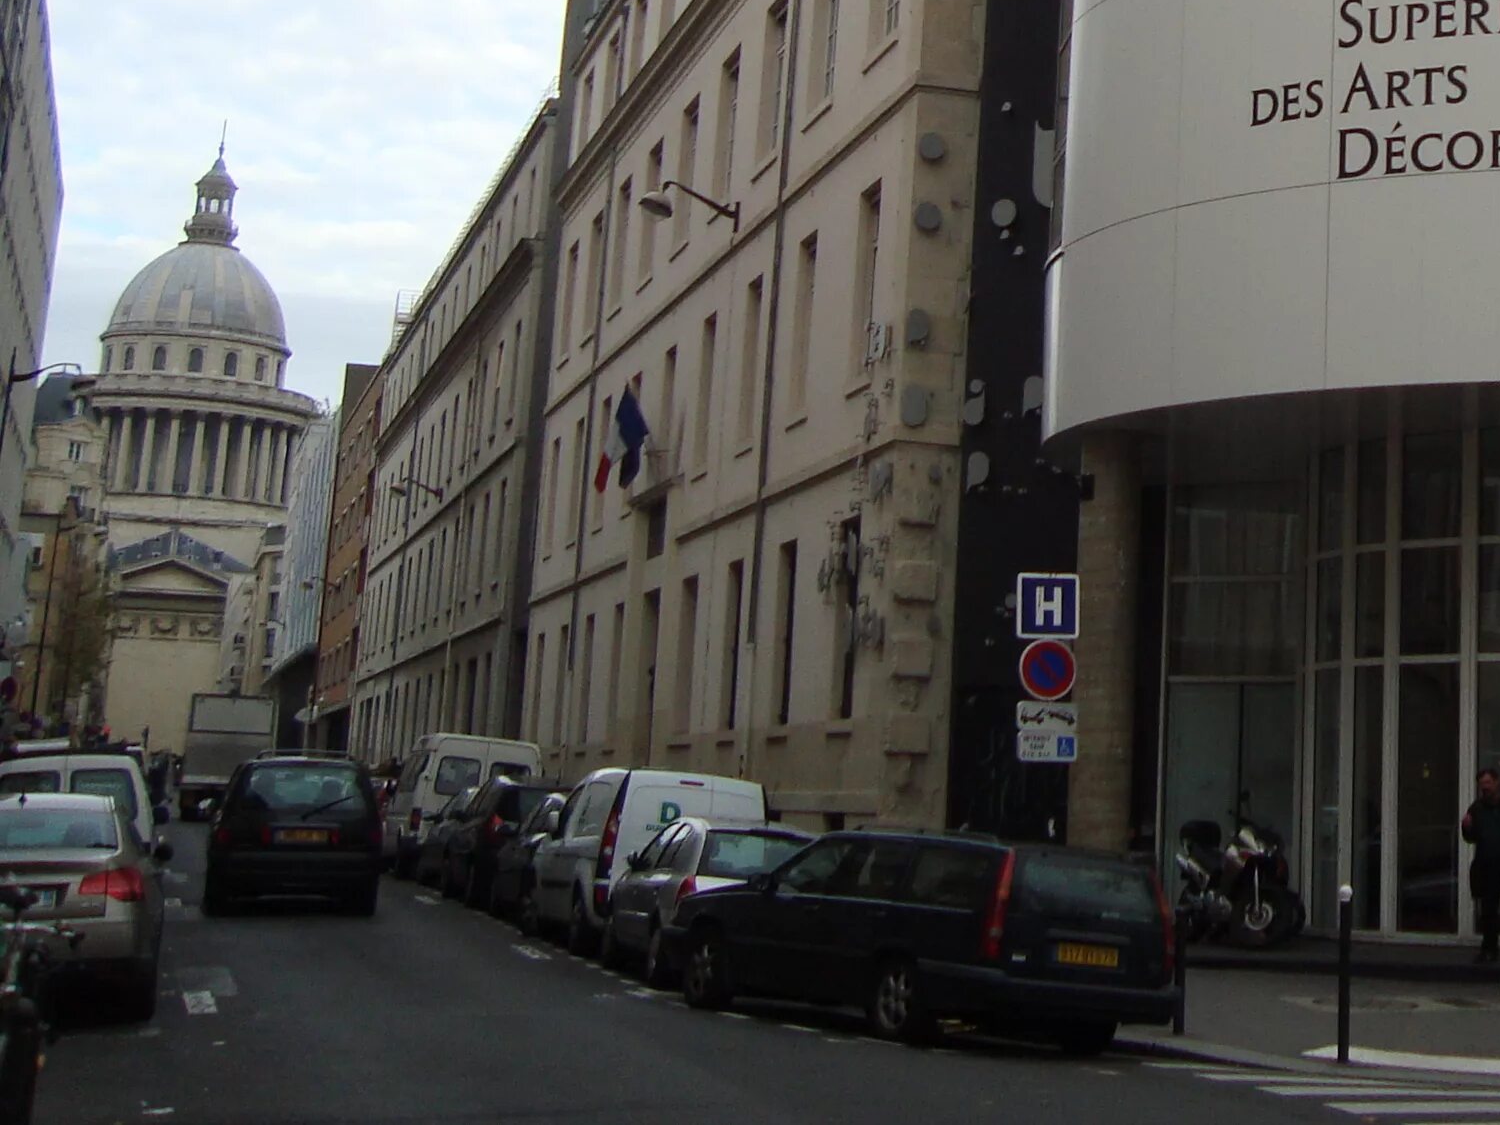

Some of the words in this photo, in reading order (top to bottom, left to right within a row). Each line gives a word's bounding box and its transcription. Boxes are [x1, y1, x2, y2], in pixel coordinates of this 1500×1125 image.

[1250, 79, 1325, 127] DES
[1340, 61, 1469, 114] ARTS
[1035, 585, 1063, 627] H
[660, 801, 681, 822] D
